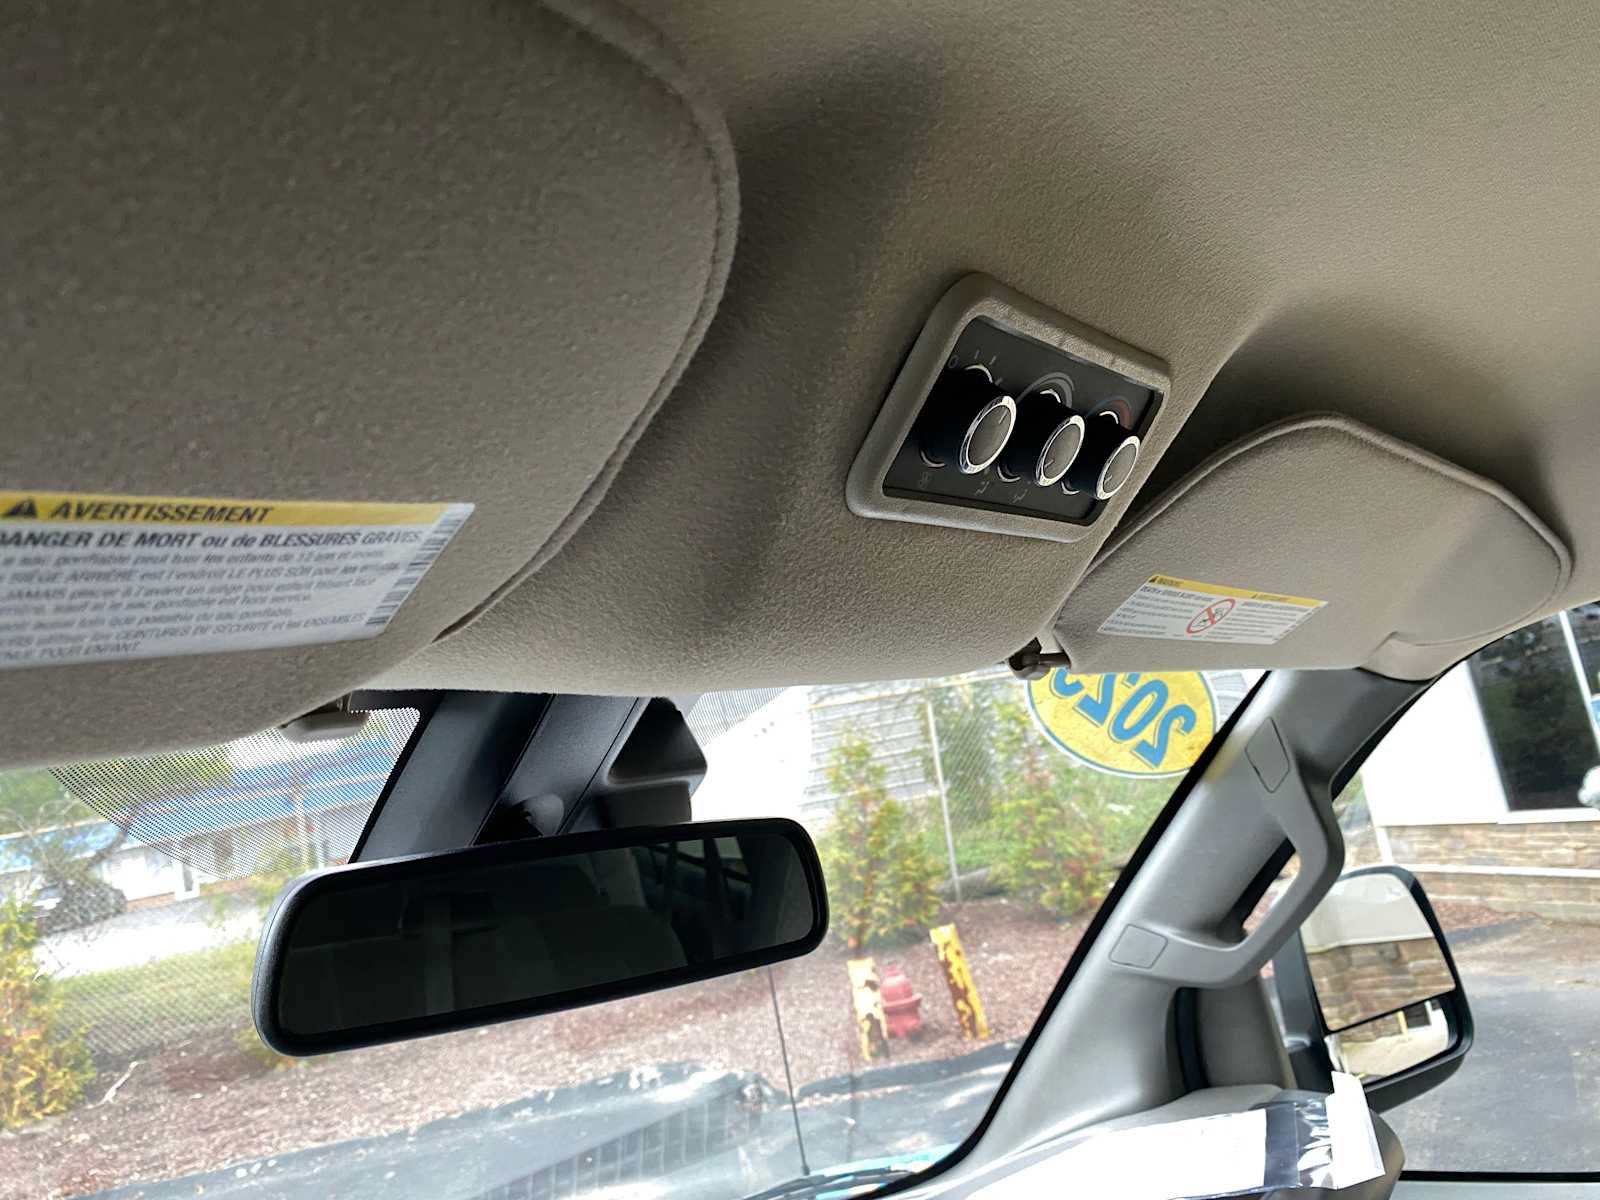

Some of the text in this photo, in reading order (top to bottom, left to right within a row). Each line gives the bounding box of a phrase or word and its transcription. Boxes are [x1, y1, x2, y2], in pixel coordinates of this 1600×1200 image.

[50, 500, 274, 523] AVERTISSEMENT
[97, 531, 133, 548] DE
[135, 532, 202, 548] MORT
[201, 535, 228, 548] ou
[231, 533, 258, 548] de
[258, 532, 361, 548] BLESSURES
